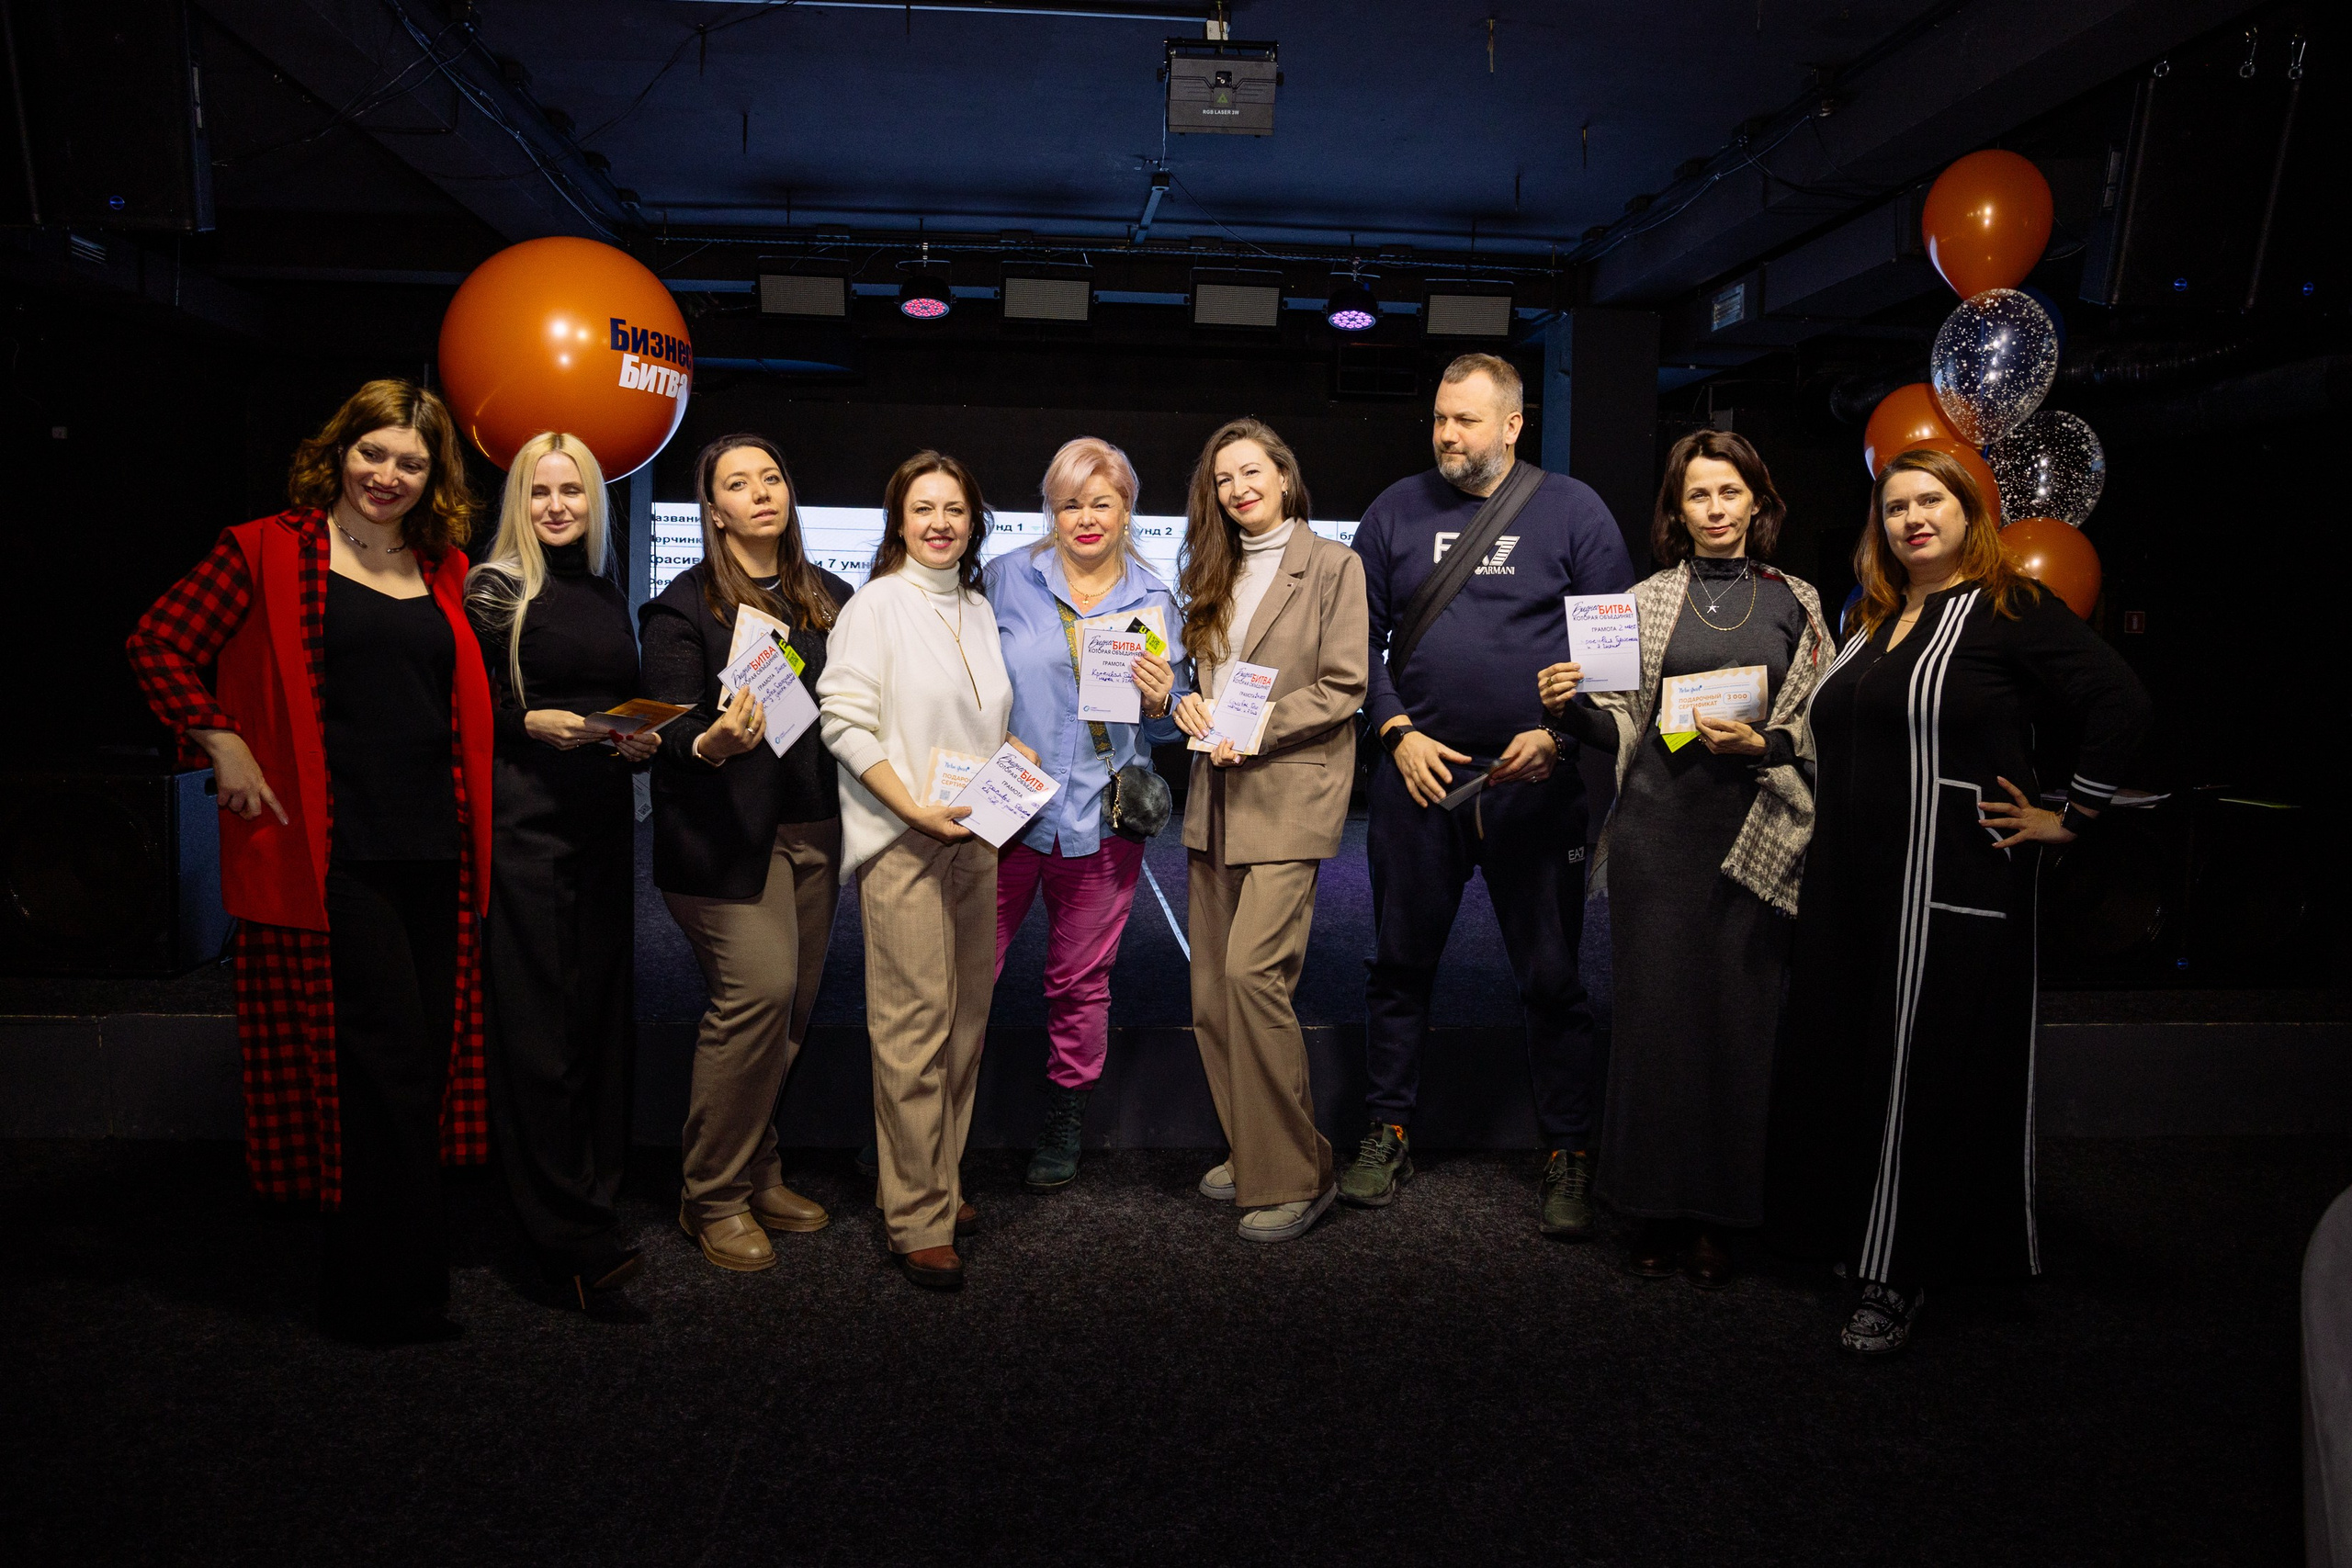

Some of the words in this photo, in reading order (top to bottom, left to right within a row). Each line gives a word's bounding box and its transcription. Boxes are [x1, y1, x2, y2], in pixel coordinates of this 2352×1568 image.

[610, 318, 693, 370] Бизнес
[618, 353, 688, 400] Битва
[1016, 523, 1023, 531] 1
[1165, 526, 1172, 536] 2
[828, 558, 836, 568] 7
[1482, 566, 1515, 575] ARMANI
[1599, 604, 1633, 615] БИТВА
[1113, 641, 1142, 651] БИТВА
[750, 645, 776, 671] БИТВА
[756, 651, 780, 676] ОБЪЕДИНЯЕТ
[757, 672, 775, 692] ГРАМОТА
[1251, 674, 1272, 684] БИТВА
[1679, 694, 1722, 704] ПОДАРОЧНЫЙ
[1679, 701, 1718, 710] СЕРТИФИКАТ
[943, 772, 970, 784] ПОДАРО
[996, 761, 1018, 780] КОТОРАЯ
[1016, 775, 1037, 795] ОБЪЕДИ
[1001, 780, 1023, 799] ГРАМОТА
[1568, 846, 1585, 861] EA7
